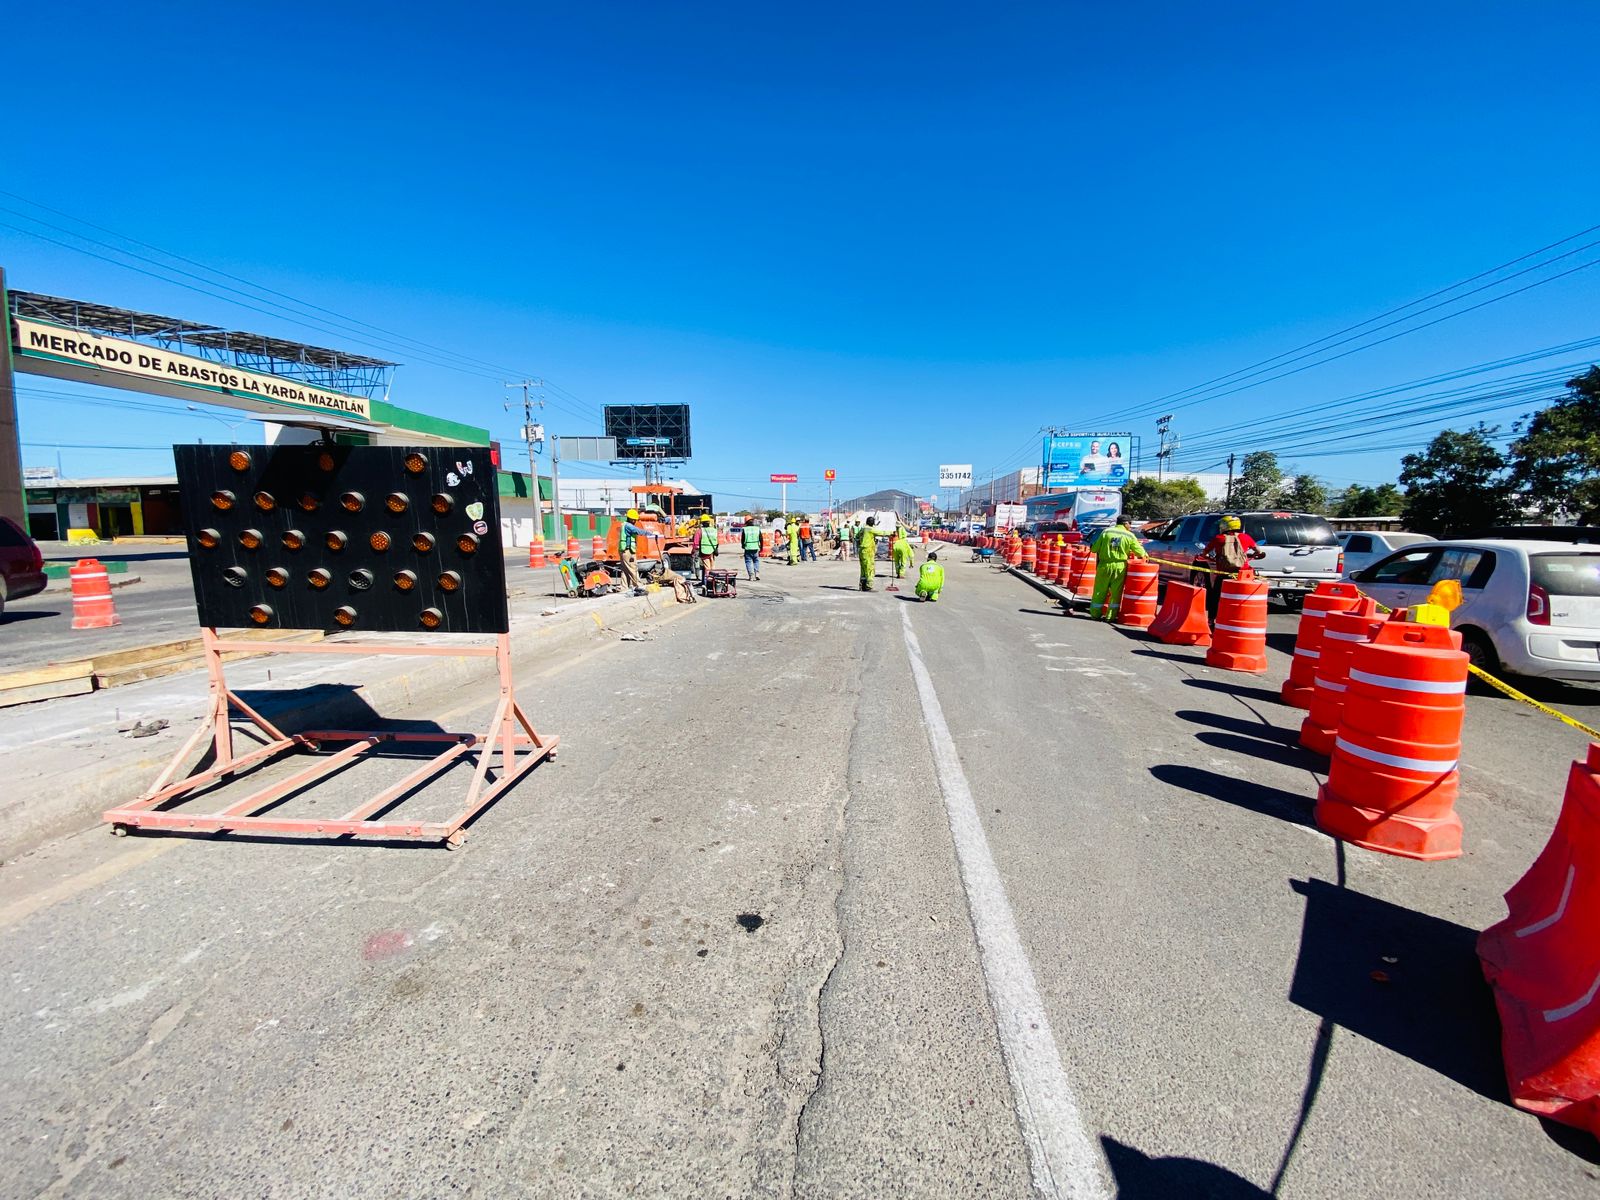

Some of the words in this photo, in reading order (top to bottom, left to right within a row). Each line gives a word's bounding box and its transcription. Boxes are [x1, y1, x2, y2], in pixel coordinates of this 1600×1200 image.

[30, 331, 132, 364] MERCADO
[138, 354, 162, 371] DE
[167, 361, 238, 387] ABASTOS
[243, 378, 260, 392] LA
[263, 382, 305, 402] YARDA
[308, 393, 364, 414] MAZATLÁN
